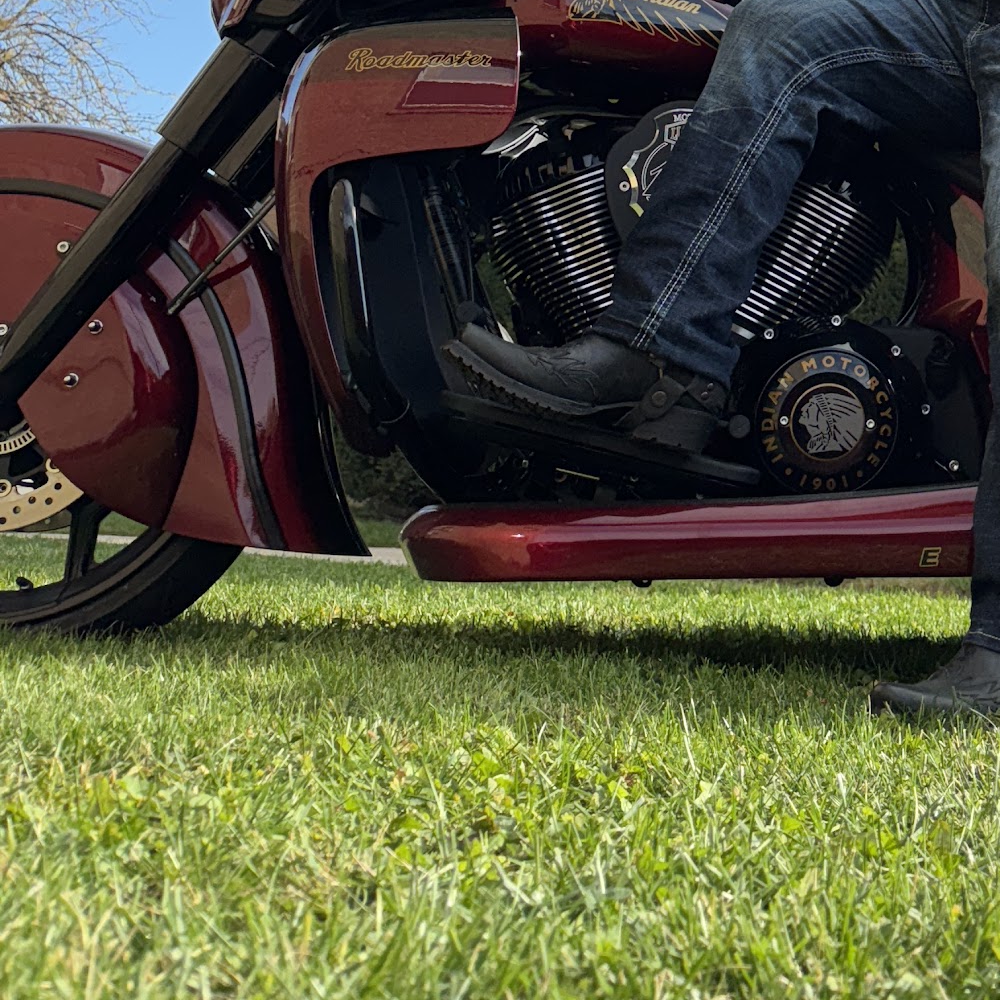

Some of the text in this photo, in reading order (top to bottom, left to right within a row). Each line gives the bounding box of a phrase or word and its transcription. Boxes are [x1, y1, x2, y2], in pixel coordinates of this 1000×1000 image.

[345, 48, 492, 72] Roadmaster
[761, 355, 892, 467] INDIAN MOTORCYCLE
[800, 474, 849, 490] 1901
